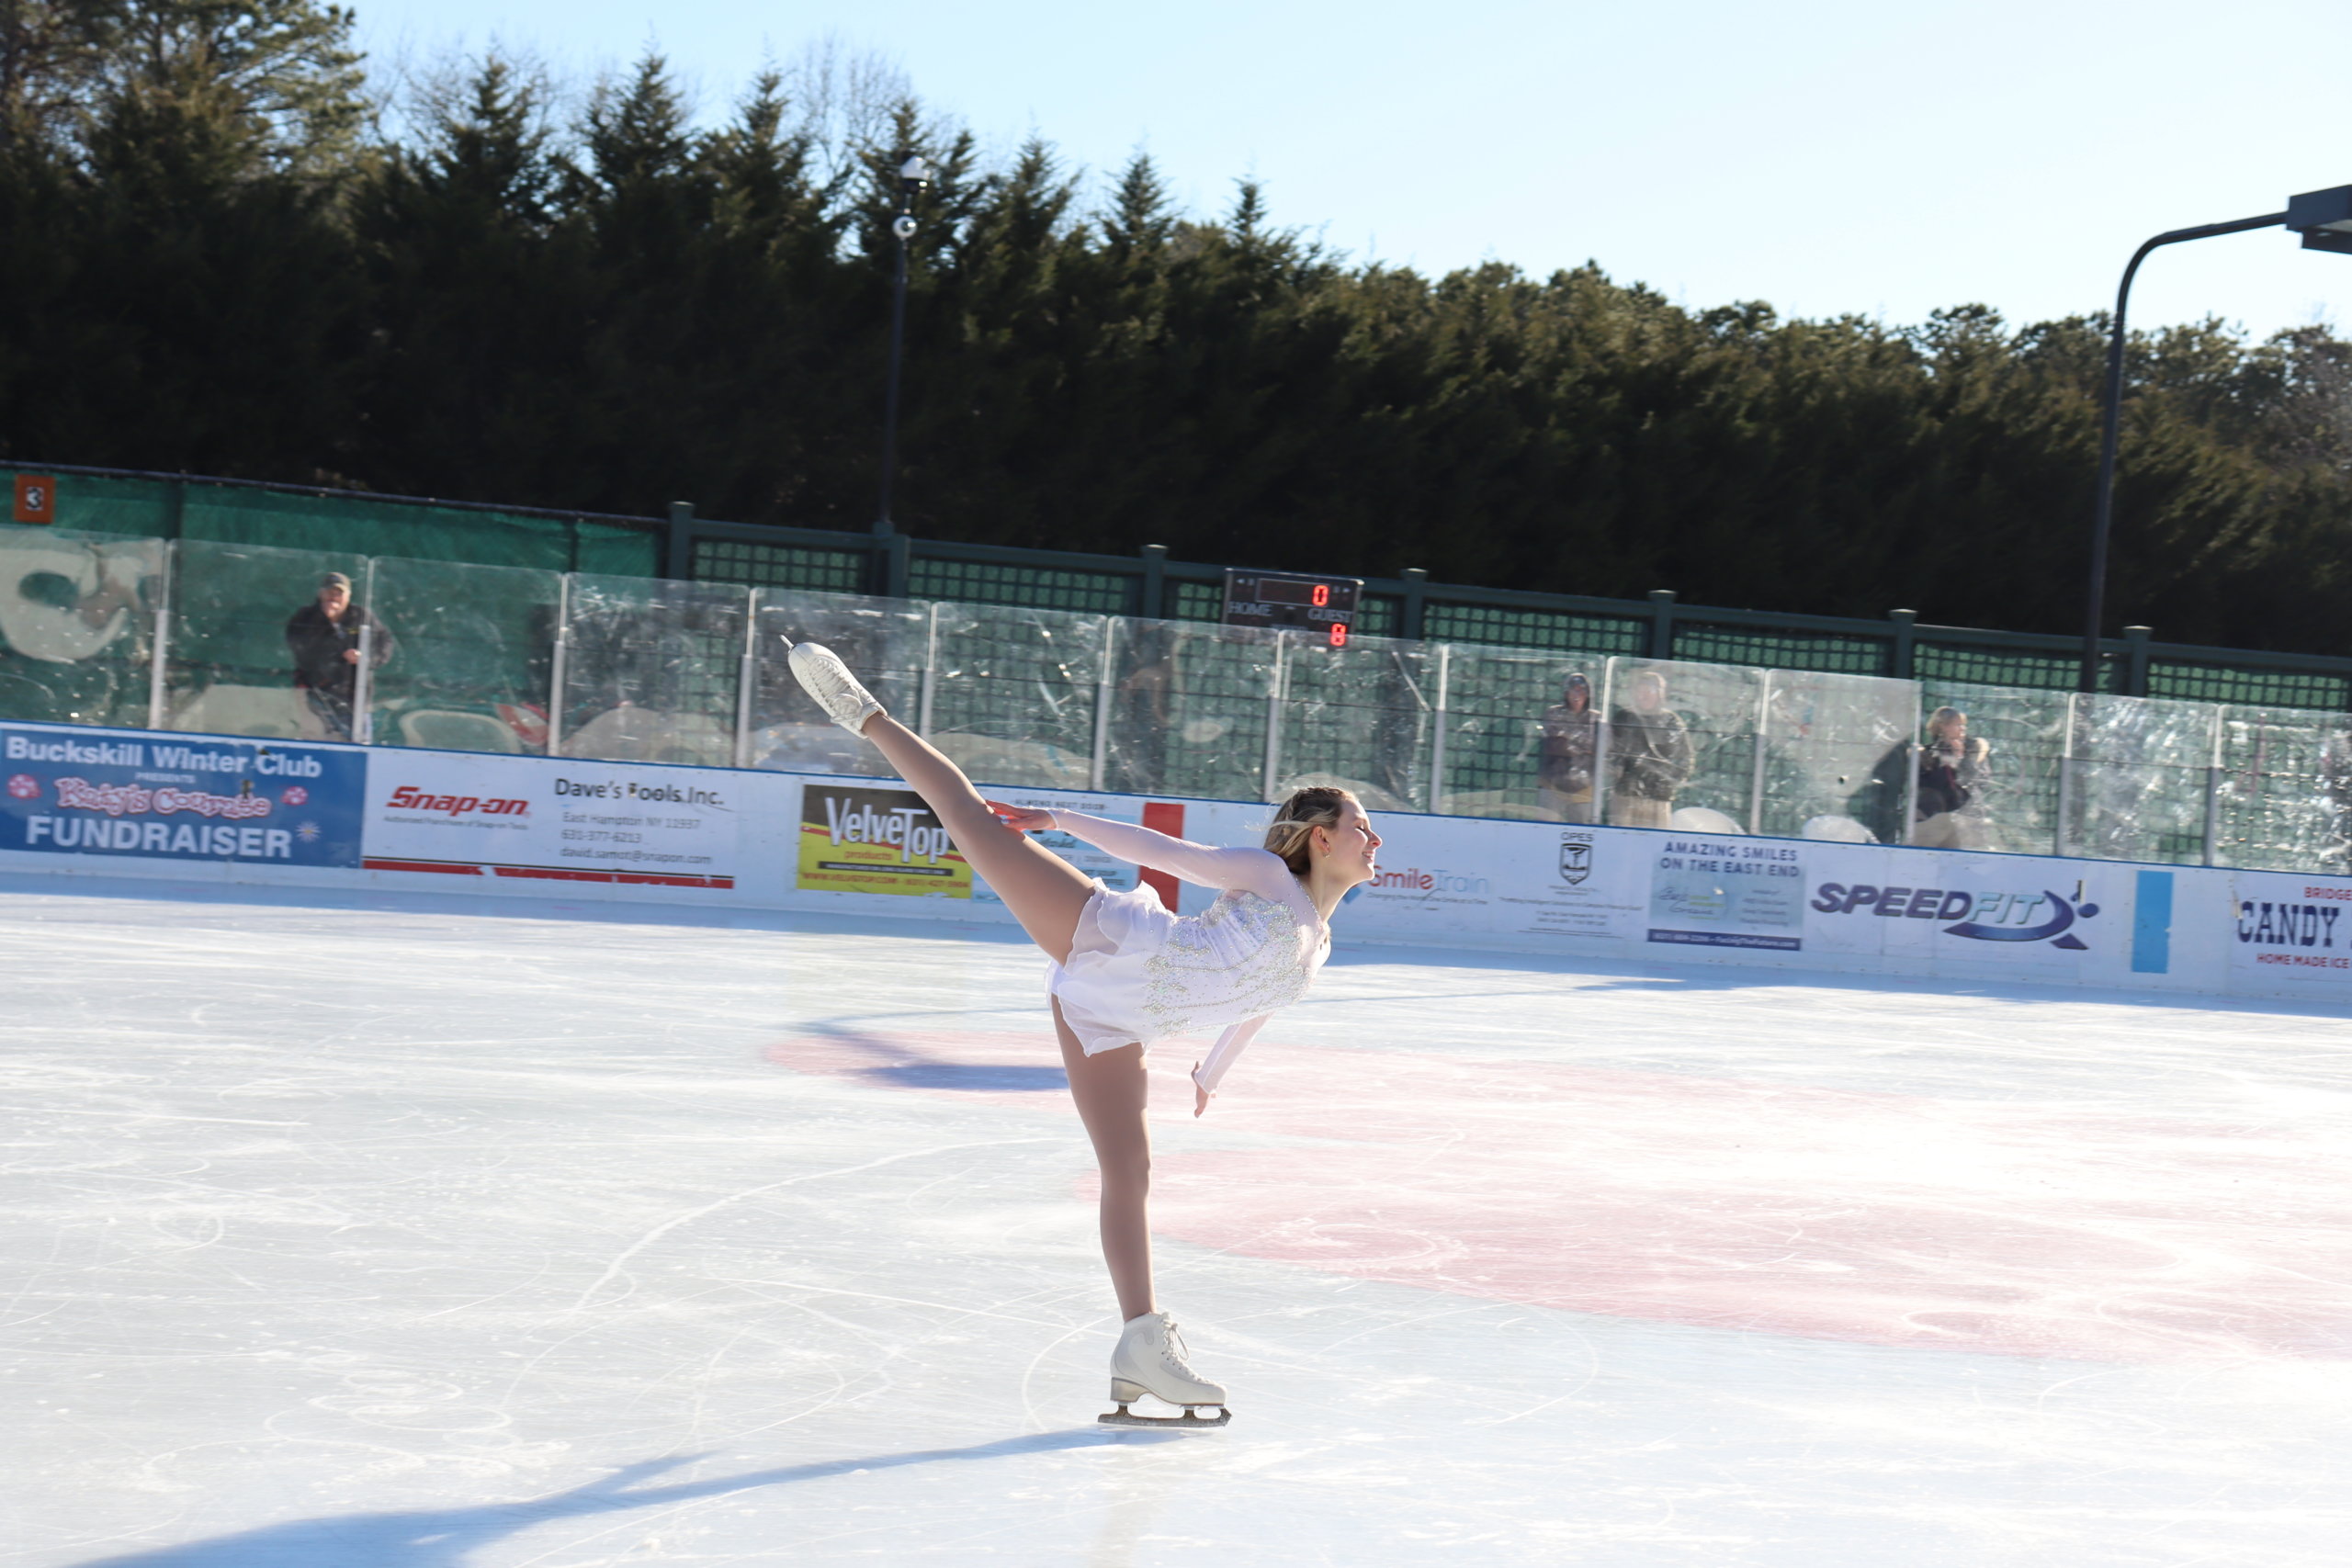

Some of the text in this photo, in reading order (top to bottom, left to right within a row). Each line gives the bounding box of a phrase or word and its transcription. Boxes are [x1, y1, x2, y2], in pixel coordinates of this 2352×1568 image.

[1313, 585, 1329, 606] 0
[1228, 602, 1354, 623] HOME GUEST
[6, 736, 322, 778] Buckskill Winter Club
[555, 778, 623, 799] Dave's
[387, 785, 529, 817] Snap-on
[562, 812, 587, 824] East
[589, 815, 642, 829] Hampton
[825, 797, 950, 863] VelveTop
[28, 815, 293, 858] FUNDRAISER
[1665, 841, 1798, 862] AMAZING SMILES
[1659, 857, 1800, 878] ON THE EAST END
[1811, 882, 2046, 925] SPEEDFIT
[2238, 901, 2340, 947] CANDY
[2256, 953, 2350, 969] HOME MADE ICE
